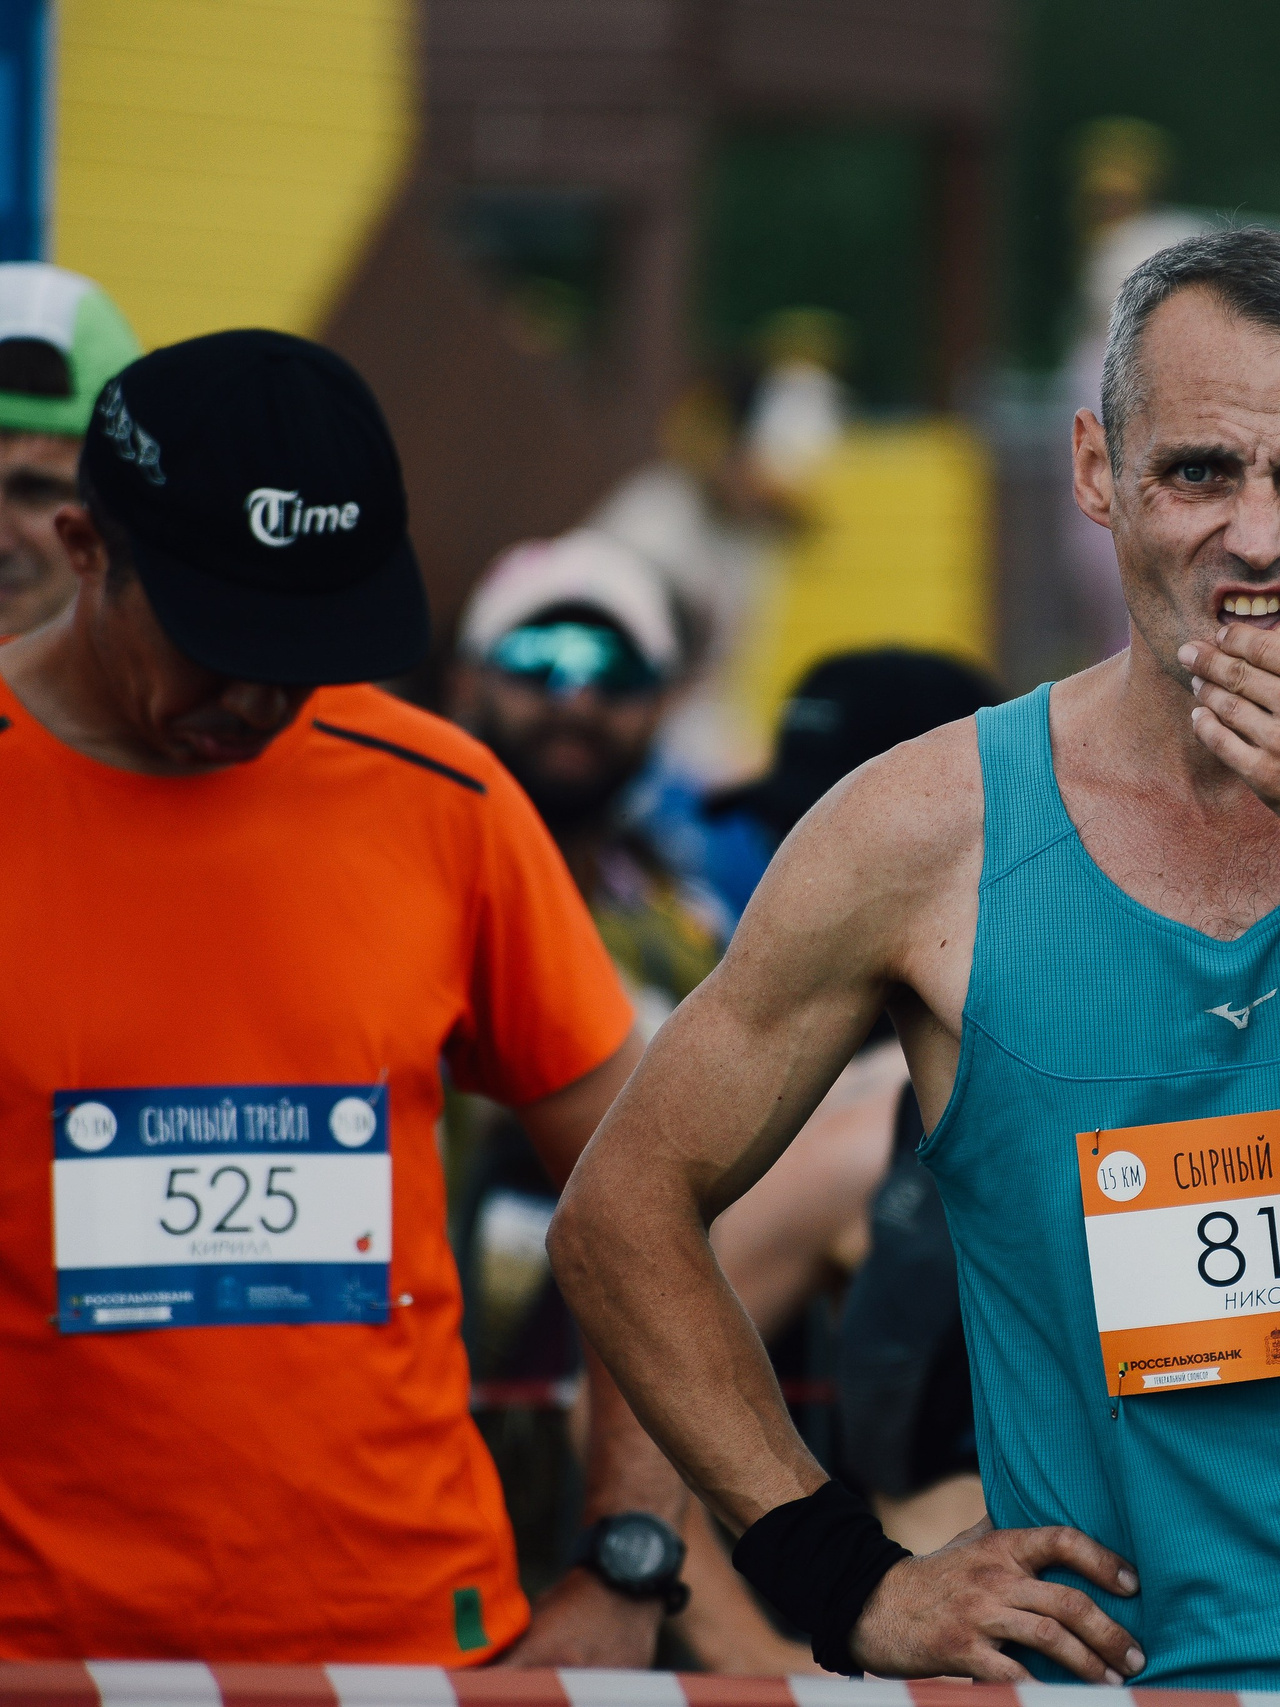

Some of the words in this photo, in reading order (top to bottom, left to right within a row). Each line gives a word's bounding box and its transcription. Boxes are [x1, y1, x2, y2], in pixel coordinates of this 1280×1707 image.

[244, 486, 361, 549] Time
[139, 1096, 239, 1147] СЫРНЫЙ
[242, 1096, 311, 1143] ТРЕЙЛ
[1100, 1167, 1117, 1190] 15
[1172, 1133, 1274, 1191] СЫРНЫЙ
[159, 1165, 299, 1236] 525
[1130, 1348, 1243, 1371] РОССЕЛЬХОЗБАНК
